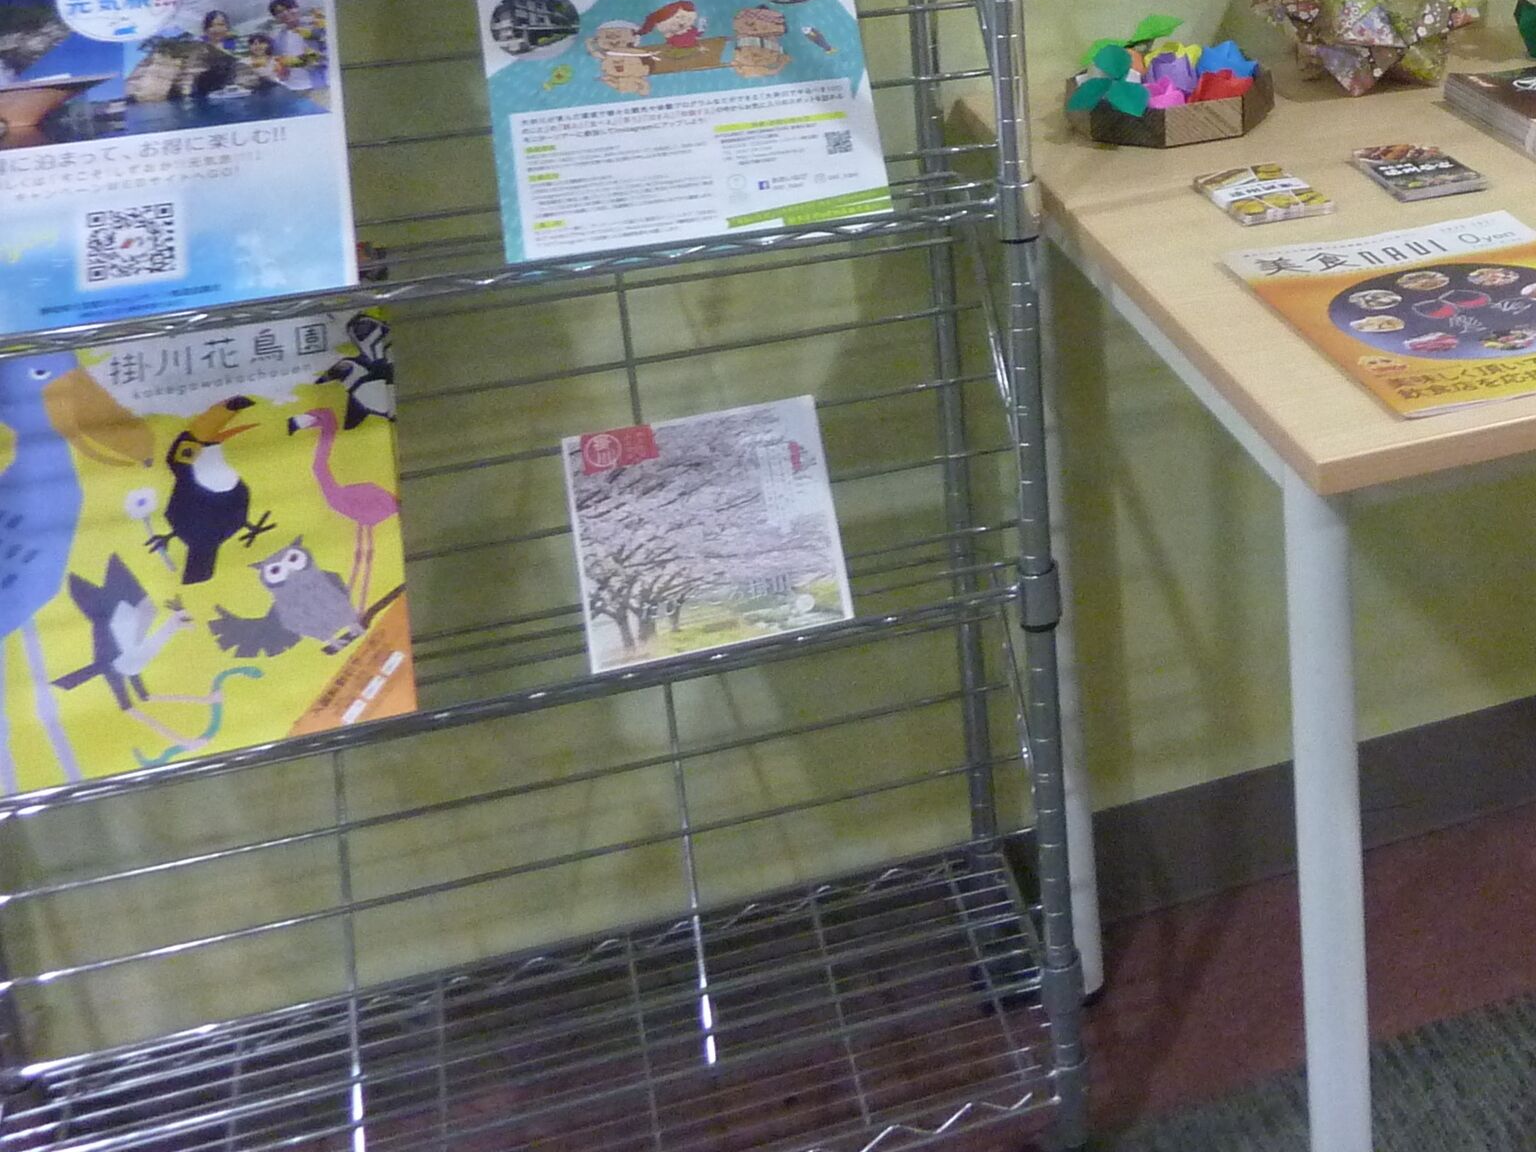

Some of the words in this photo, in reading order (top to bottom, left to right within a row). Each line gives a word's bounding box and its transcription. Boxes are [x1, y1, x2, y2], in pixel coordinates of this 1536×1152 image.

[109, 323, 329, 386] 掛川花鳥園
